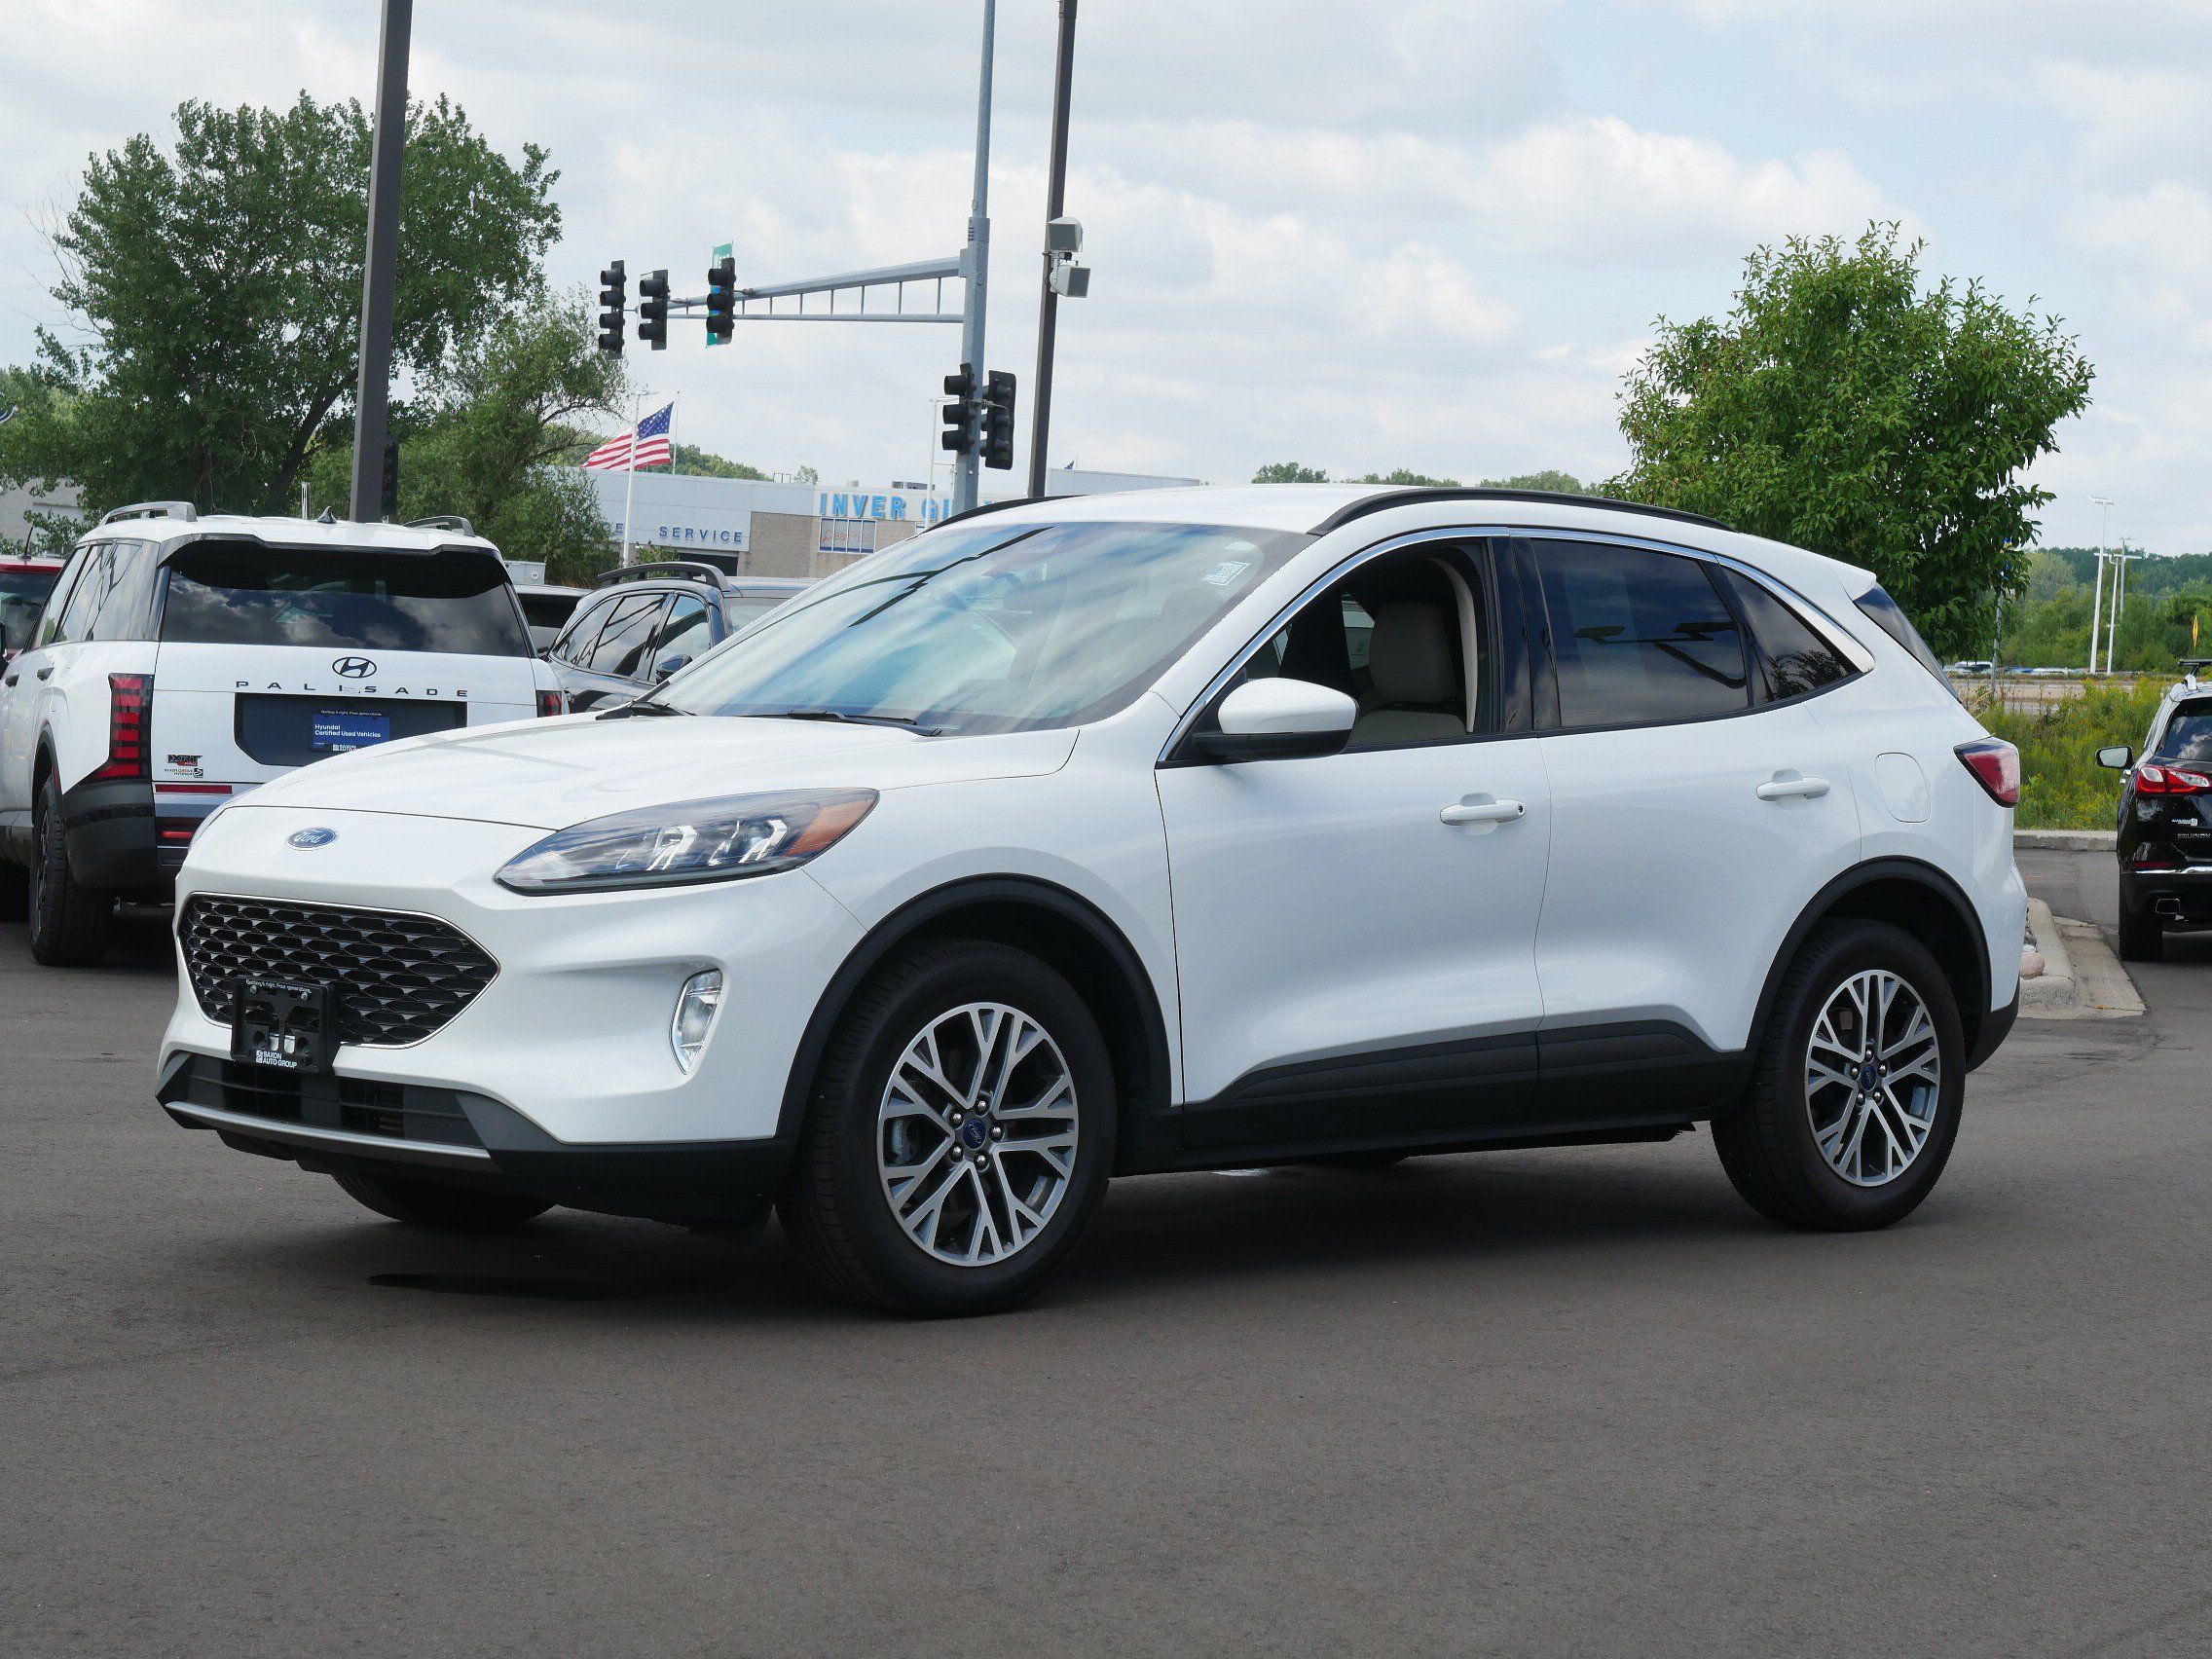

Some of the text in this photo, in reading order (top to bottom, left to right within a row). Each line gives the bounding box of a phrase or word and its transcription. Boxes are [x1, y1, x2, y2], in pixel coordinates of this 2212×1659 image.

[819, 493, 906, 521] INVER
[659, 526, 743, 543] SERVICE
[236, 681, 468, 697] PALISADE
[262, 1057, 298, 1068] AUTO GROUP
[263, 1051, 282, 1060] SAXON
